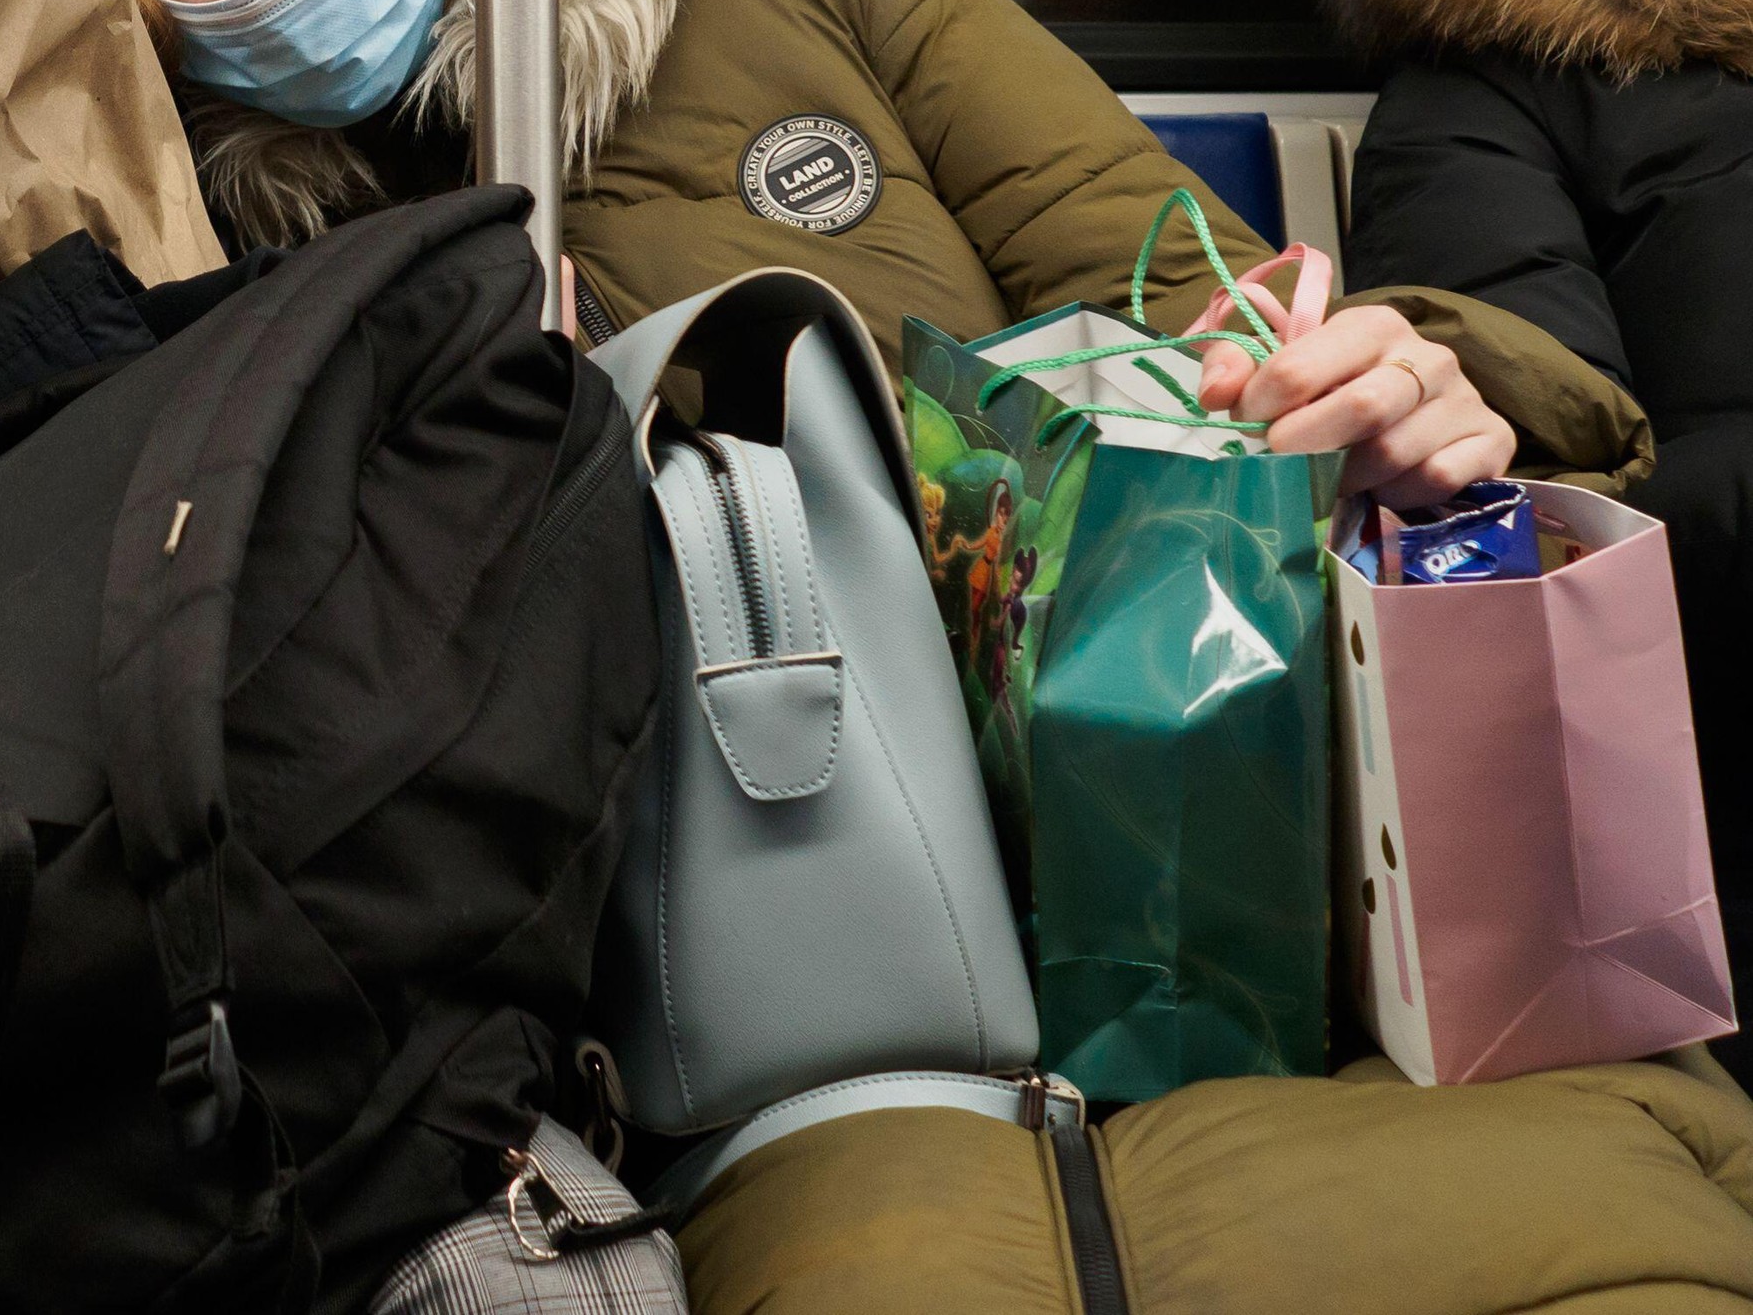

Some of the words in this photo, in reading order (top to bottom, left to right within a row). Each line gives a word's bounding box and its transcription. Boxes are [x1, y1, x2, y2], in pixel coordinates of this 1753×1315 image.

[787, 120, 815, 132] OWN
[758, 127, 785, 149] YOUR
[853, 144, 870, 162] LET
[748, 150, 763, 189] CREATE
[779, 156, 835, 190] LAND
[862, 165, 872, 175] IT
[788, 171, 845, 203] COLLECTION
[836, 194, 869, 225] UNIQUE
[808, 218, 833, 229] FOR
